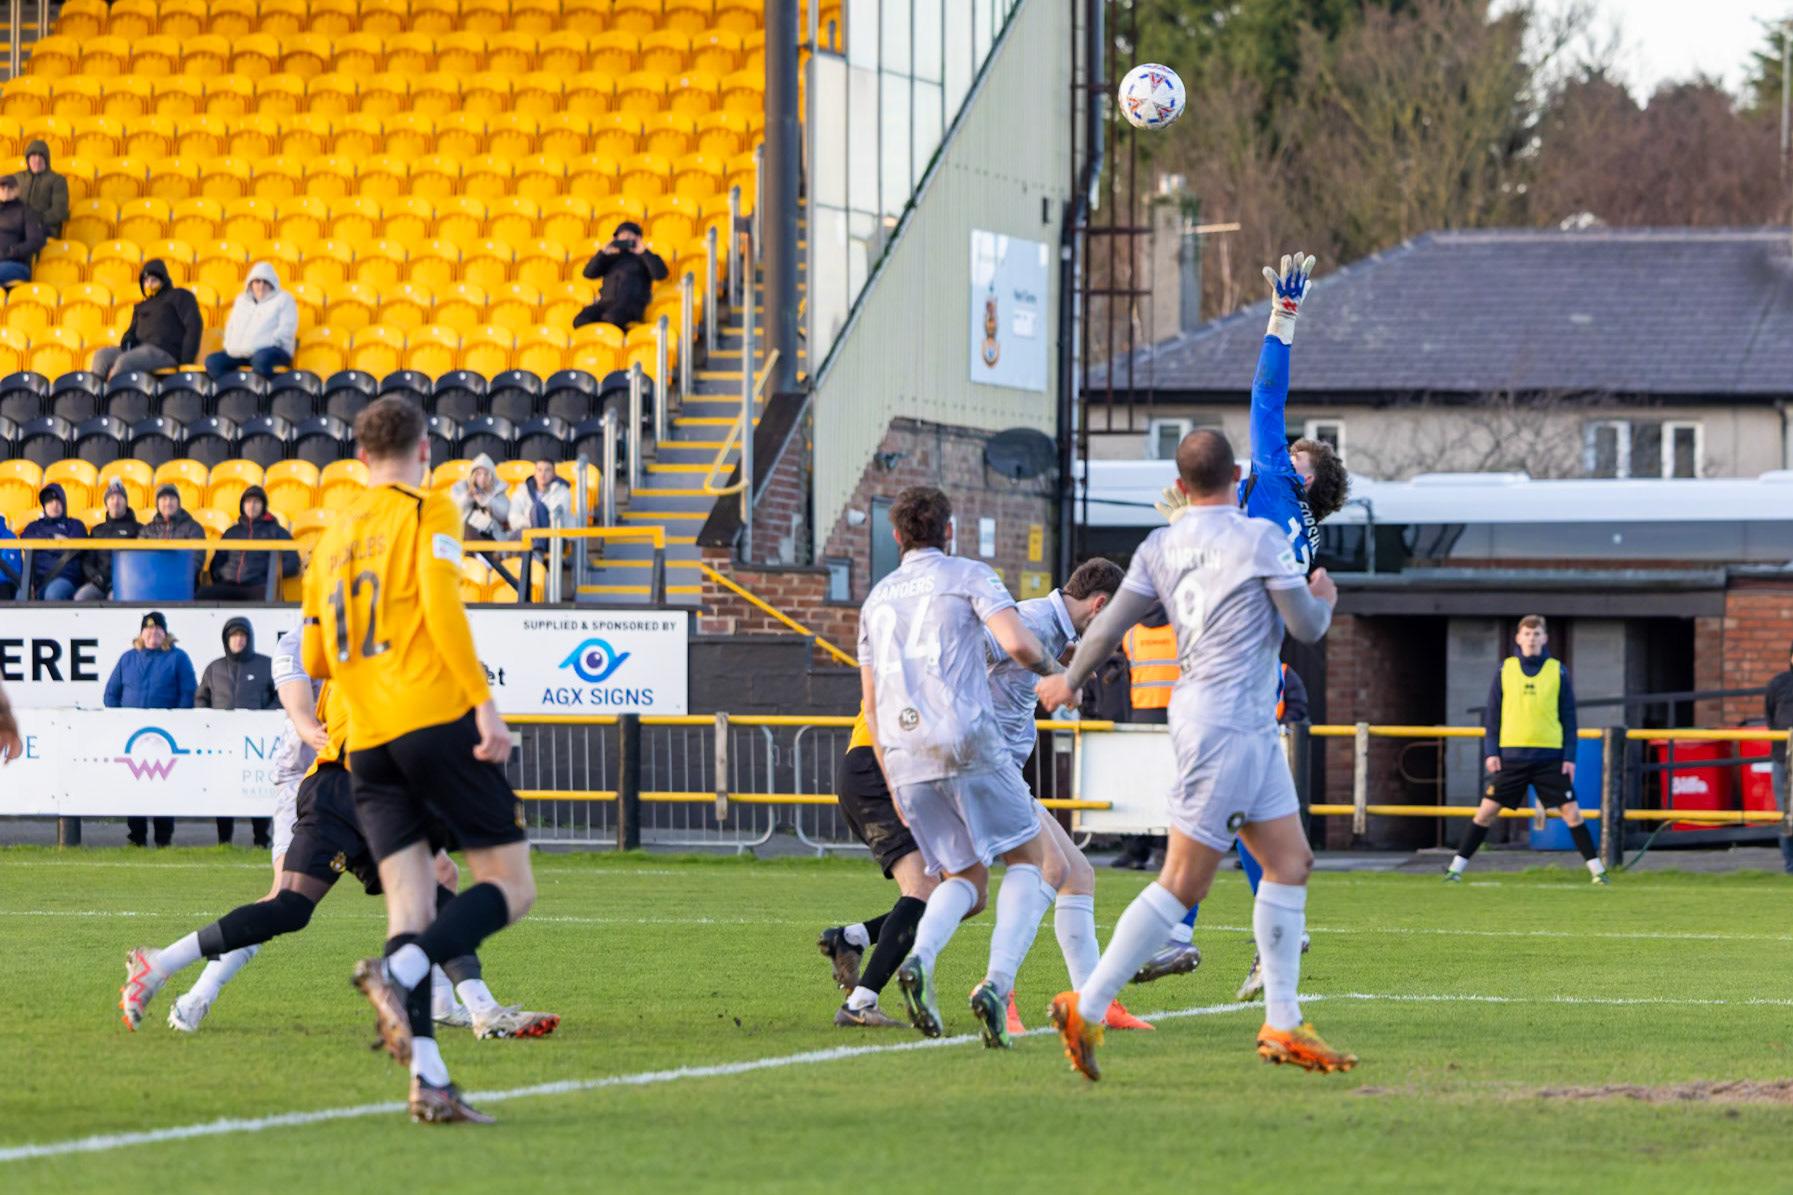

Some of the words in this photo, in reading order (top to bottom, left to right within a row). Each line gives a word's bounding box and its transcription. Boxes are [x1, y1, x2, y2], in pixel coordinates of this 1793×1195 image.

[872, 576, 935, 607] SANDERS
[328, 570, 391, 662] 12
[523, 620, 578, 631] SUPPLIED
[581, 621, 589, 630] &
[592, 621, 659, 631] SPONSORED
[662, 621, 677, 631] BY
[871, 594, 942, 677] 24
[1174, 573, 1204, 657] 9
[0, 638, 99, 681] ERE
[541, 687, 583, 705] AGX
[590, 687, 654, 706] SIGNS
